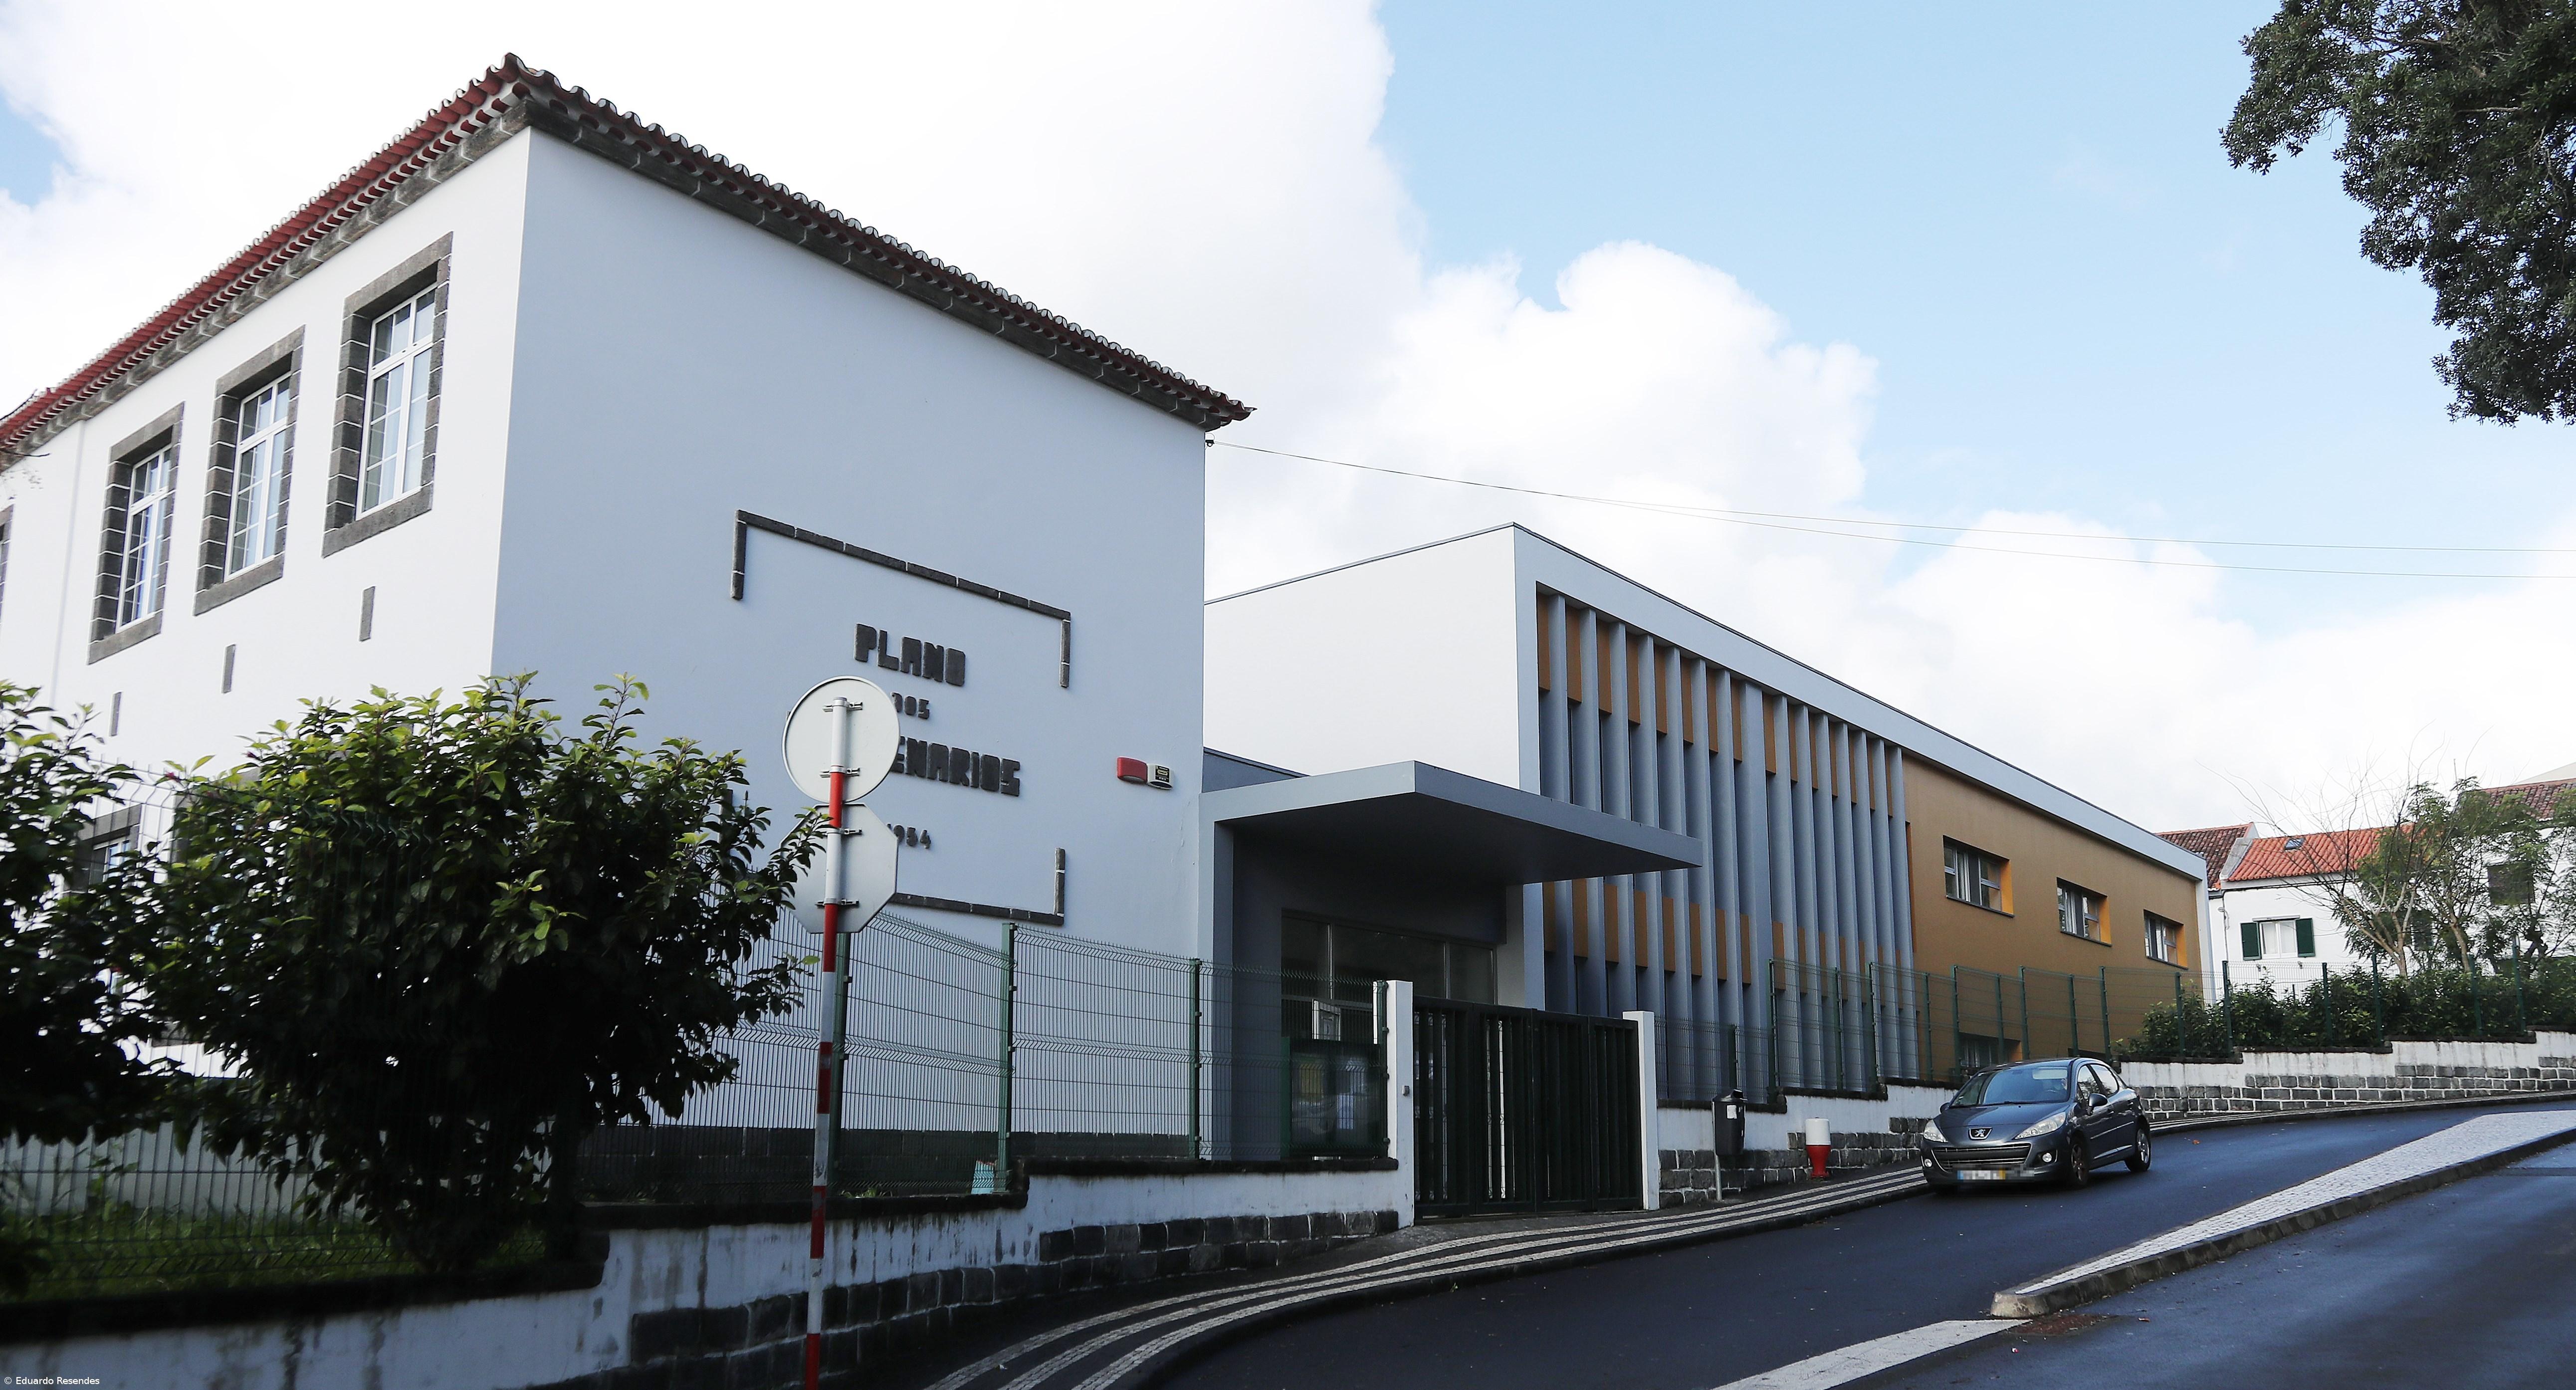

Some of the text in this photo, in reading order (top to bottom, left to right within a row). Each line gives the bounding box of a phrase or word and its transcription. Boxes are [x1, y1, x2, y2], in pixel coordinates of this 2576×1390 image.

[854, 623, 966, 687] PLANO
[889, 735, 1021, 797] ENARIOS
[887, 823, 932, 849] 954
